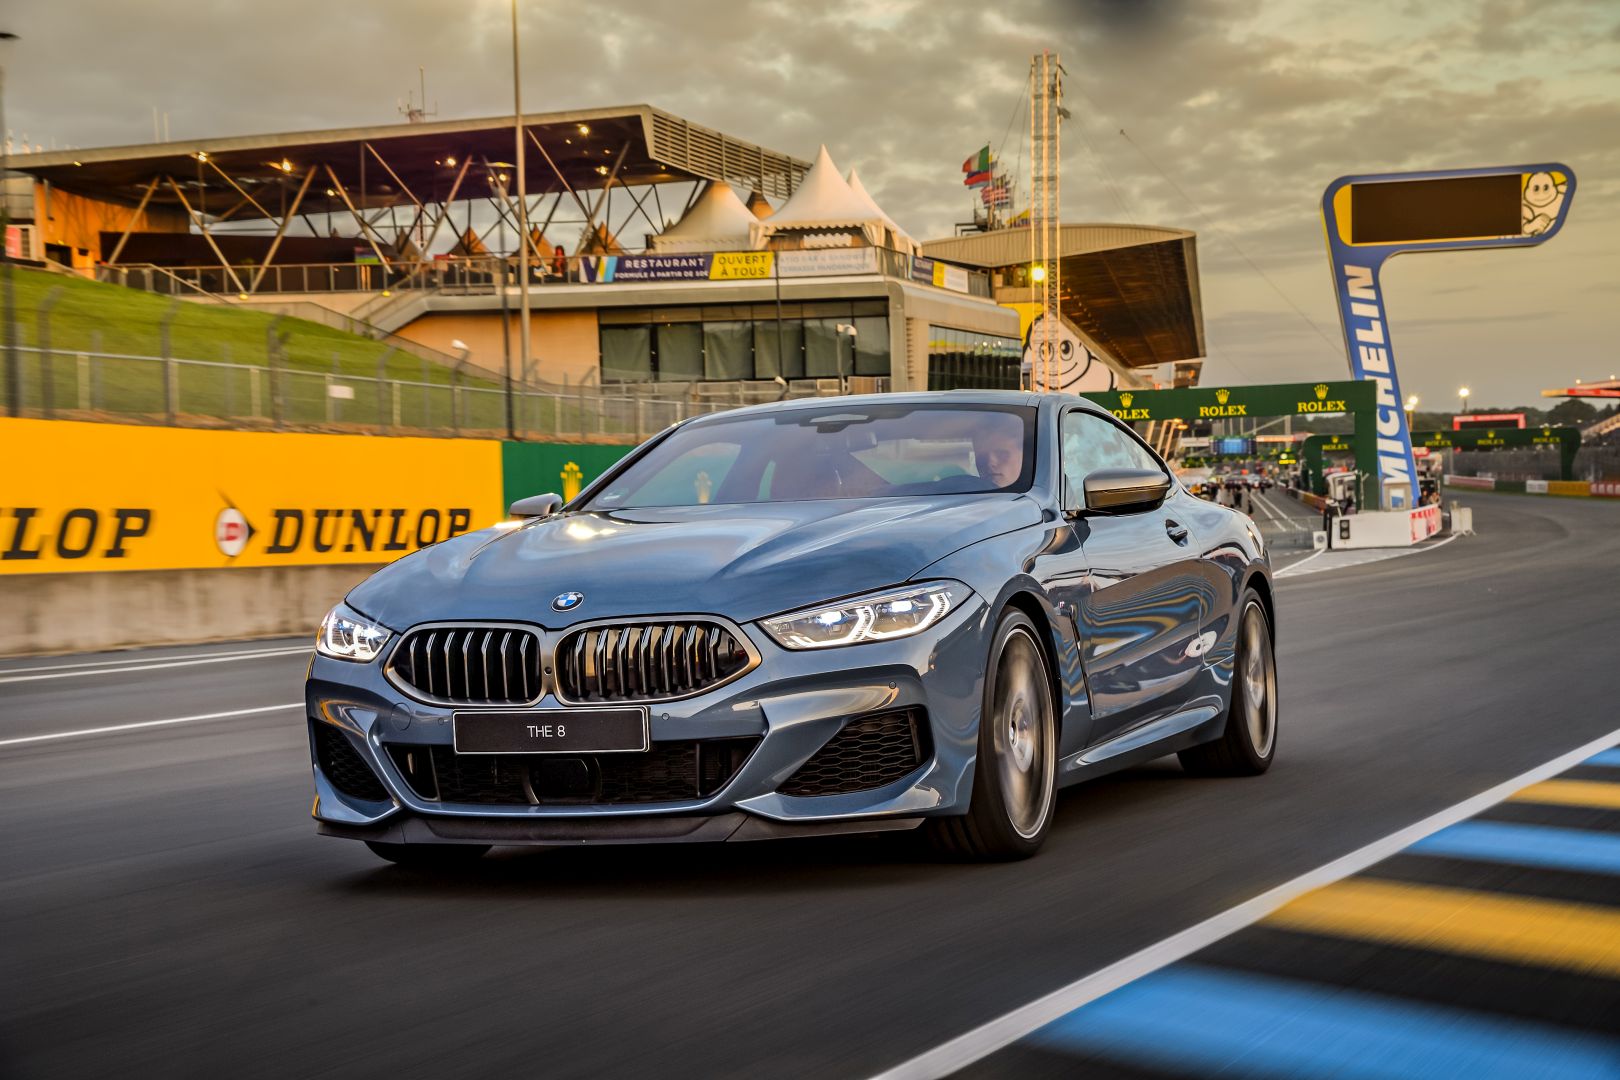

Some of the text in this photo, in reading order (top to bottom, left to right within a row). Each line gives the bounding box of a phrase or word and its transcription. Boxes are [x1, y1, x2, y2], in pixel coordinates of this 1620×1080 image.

[625, 258, 705, 268] RESTAURANT
[718, 255, 767, 265] OUVERT
[721, 266, 766, 276] À TOUS
[1344, 265, 1411, 484] MICHELIN
[1200, 405, 1247, 417] ROLEX
[1297, 400, 1346, 413] ROLEX
[1109, 409, 1150, 420] OLEX
[0, 507, 153, 561] LOP
[265, 508, 471, 554] DUNLOP
[527, 725, 566, 738] THE 8
